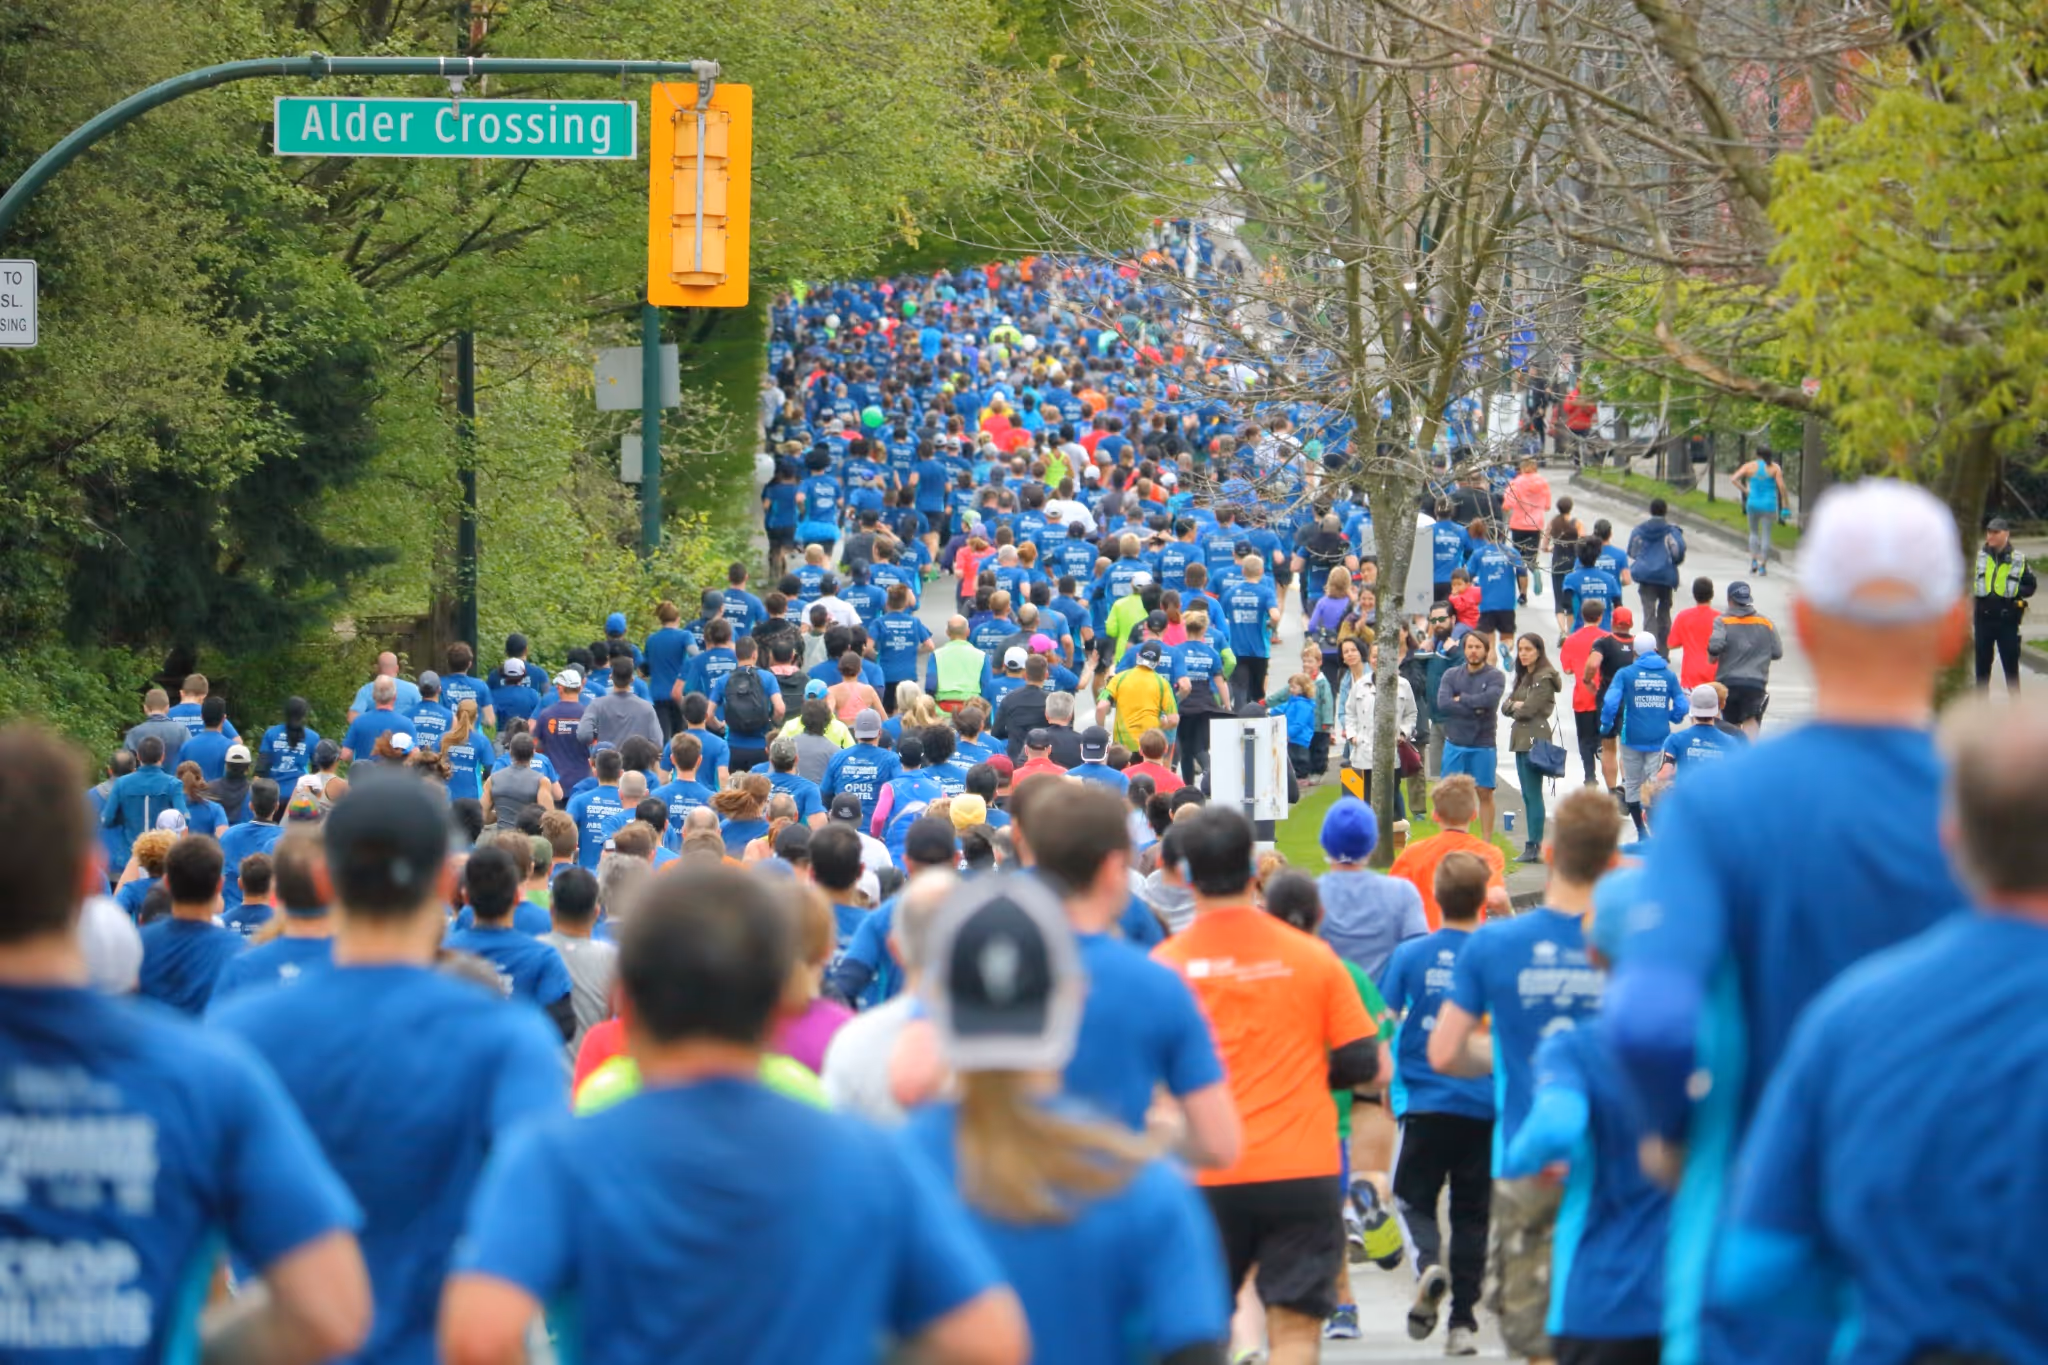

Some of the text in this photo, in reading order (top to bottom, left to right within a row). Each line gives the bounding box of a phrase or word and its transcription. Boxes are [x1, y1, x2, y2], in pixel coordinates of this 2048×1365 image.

[301, 103, 611, 155] Alder Crossing
[3, 271, 23, 285] TO
[844, 783, 873, 792] OPUS
